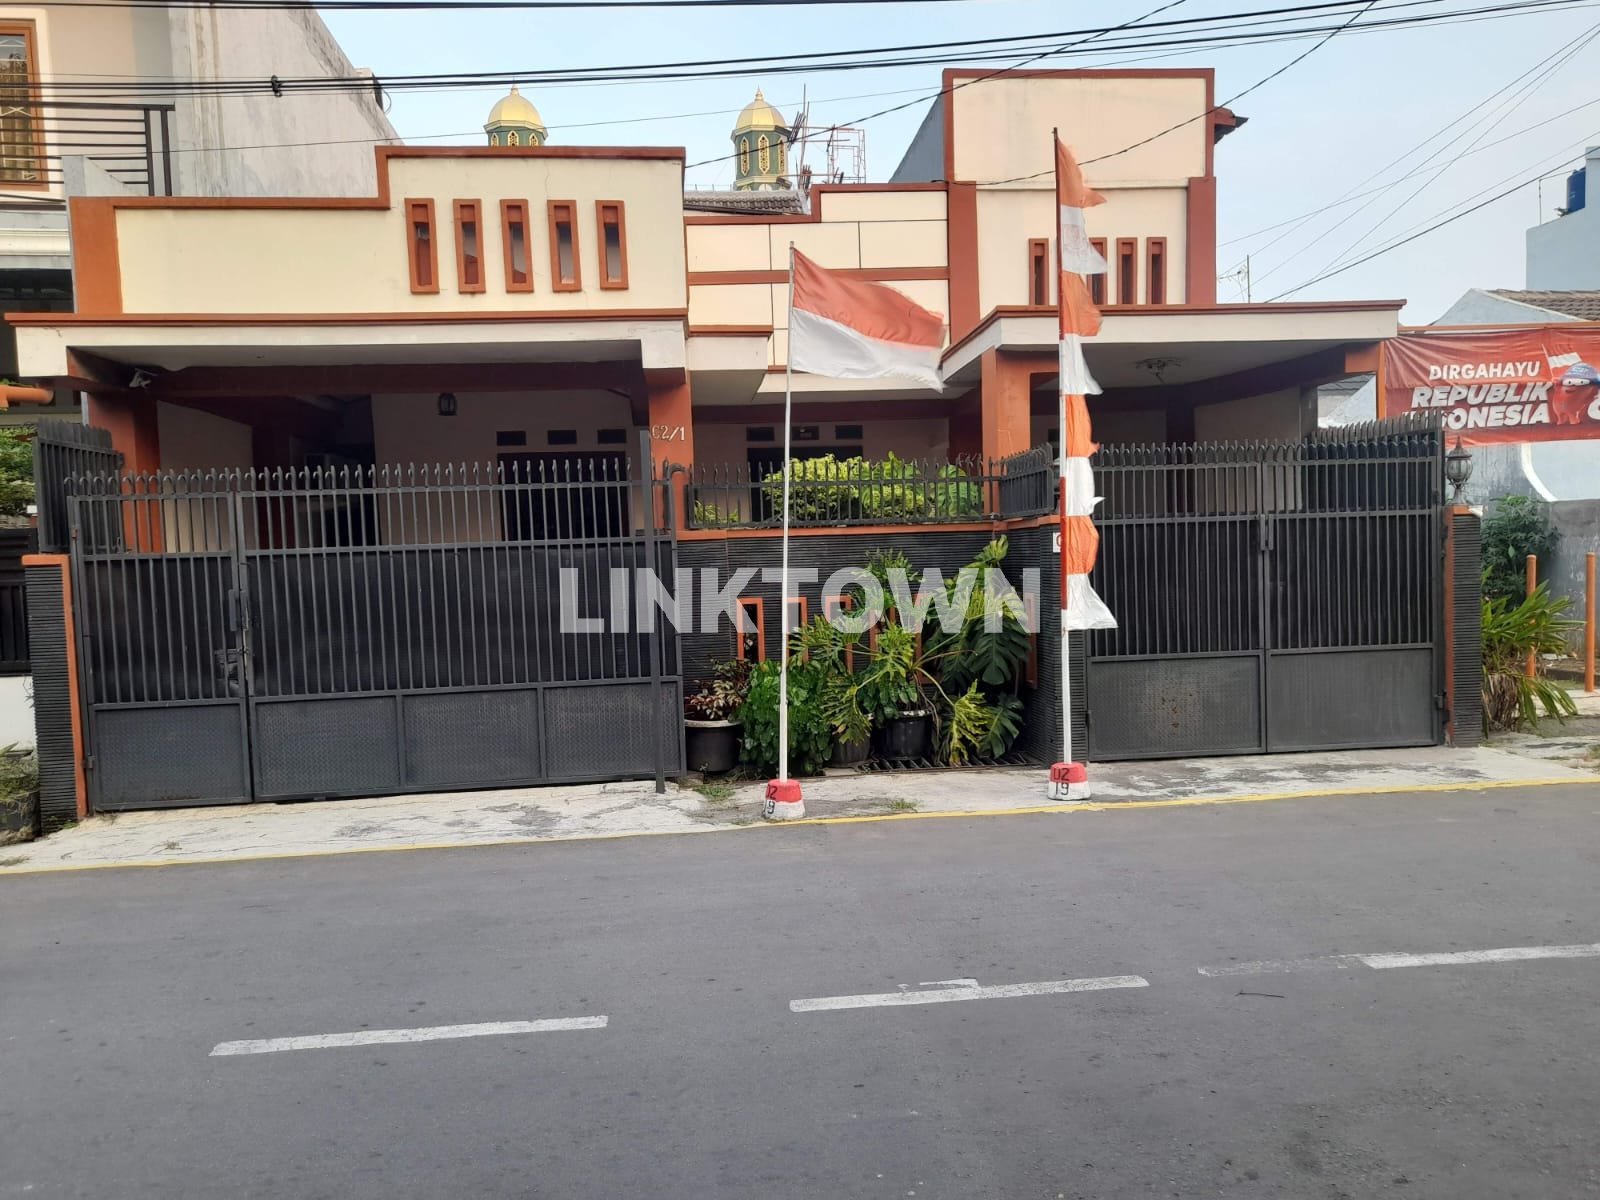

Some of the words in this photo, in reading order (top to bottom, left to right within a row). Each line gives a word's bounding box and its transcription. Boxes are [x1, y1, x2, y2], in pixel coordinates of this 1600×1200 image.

[1429, 361, 1540, 380] DIRGAHAYU
[1411, 381, 1553, 408] REPUBLIK
[1402, 403, 1550, 430] ONESIA
[652, 425, 685, 441] C2/1
